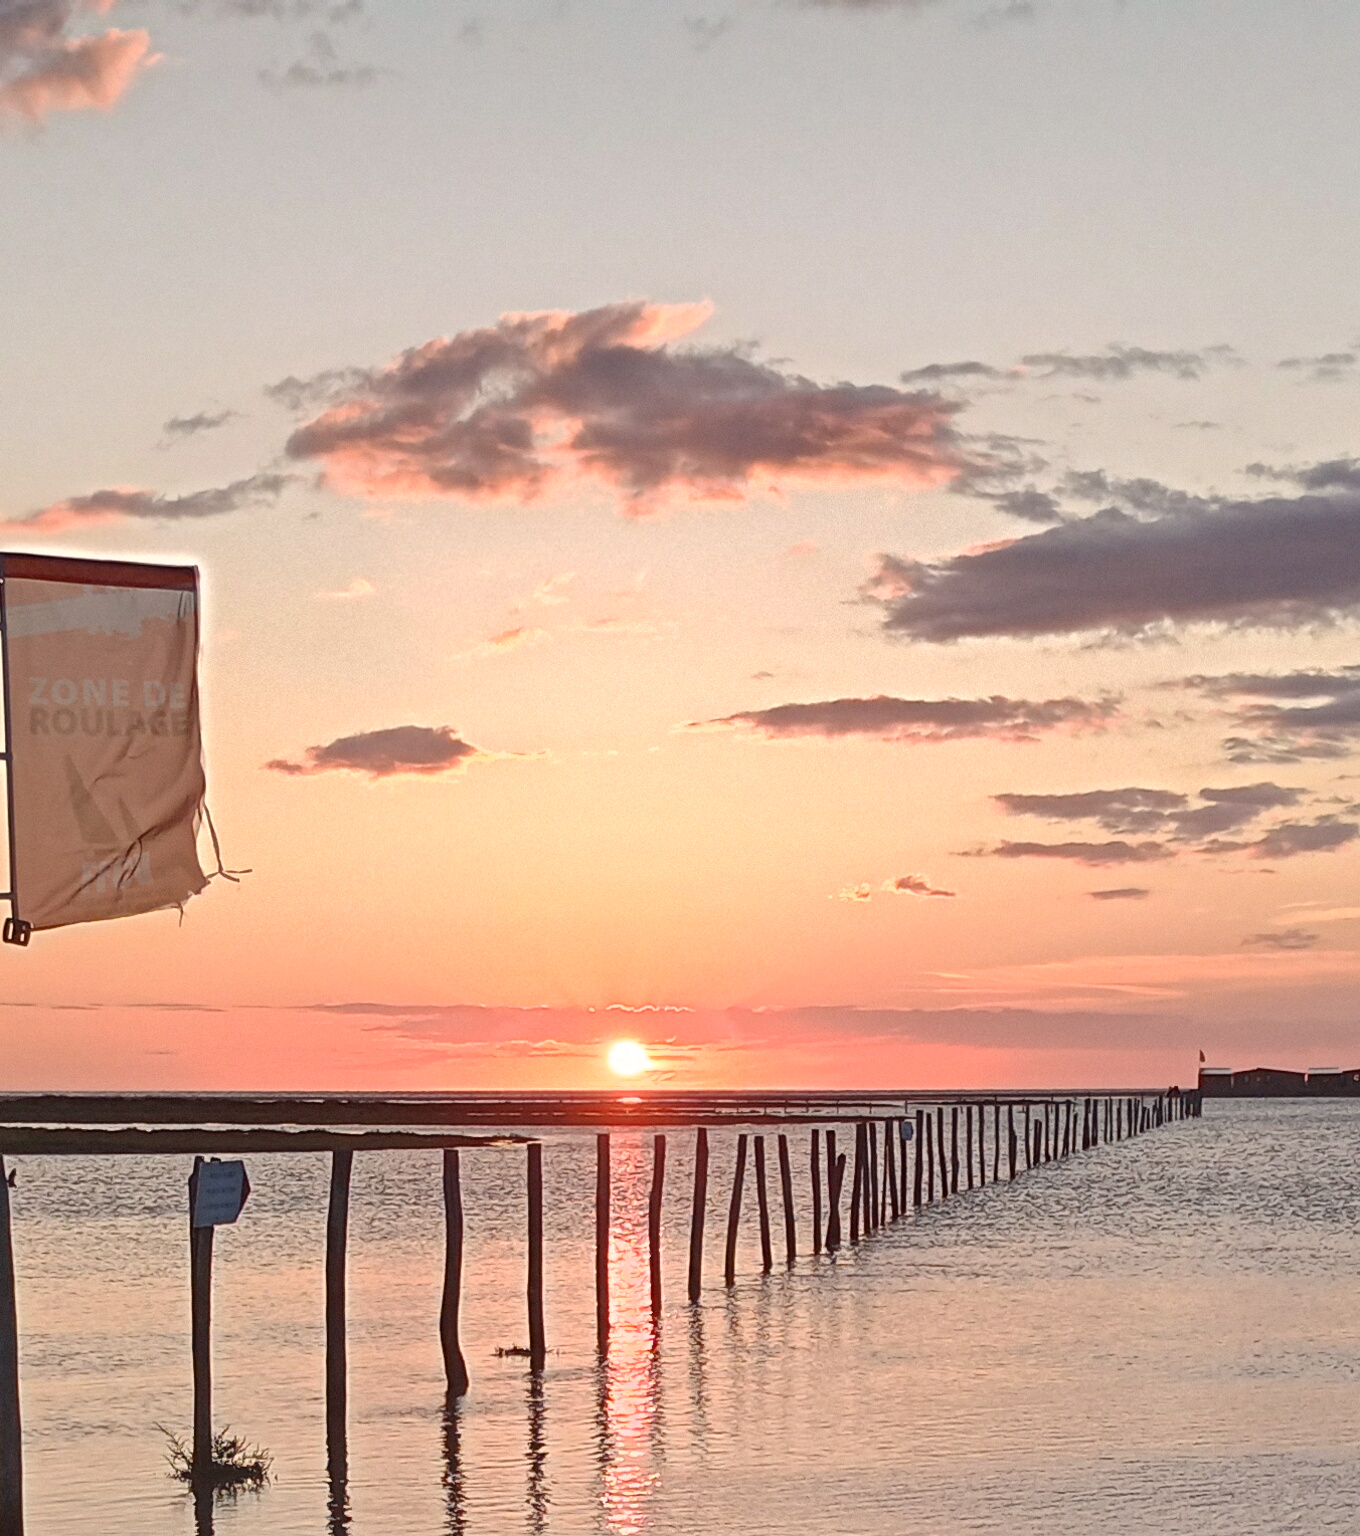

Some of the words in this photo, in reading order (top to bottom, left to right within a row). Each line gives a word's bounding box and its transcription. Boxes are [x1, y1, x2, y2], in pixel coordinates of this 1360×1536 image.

[29, 678, 131, 708] ZONE
[143, 680, 189, 709] DE
[30, 708, 191, 738] ROULAGE
